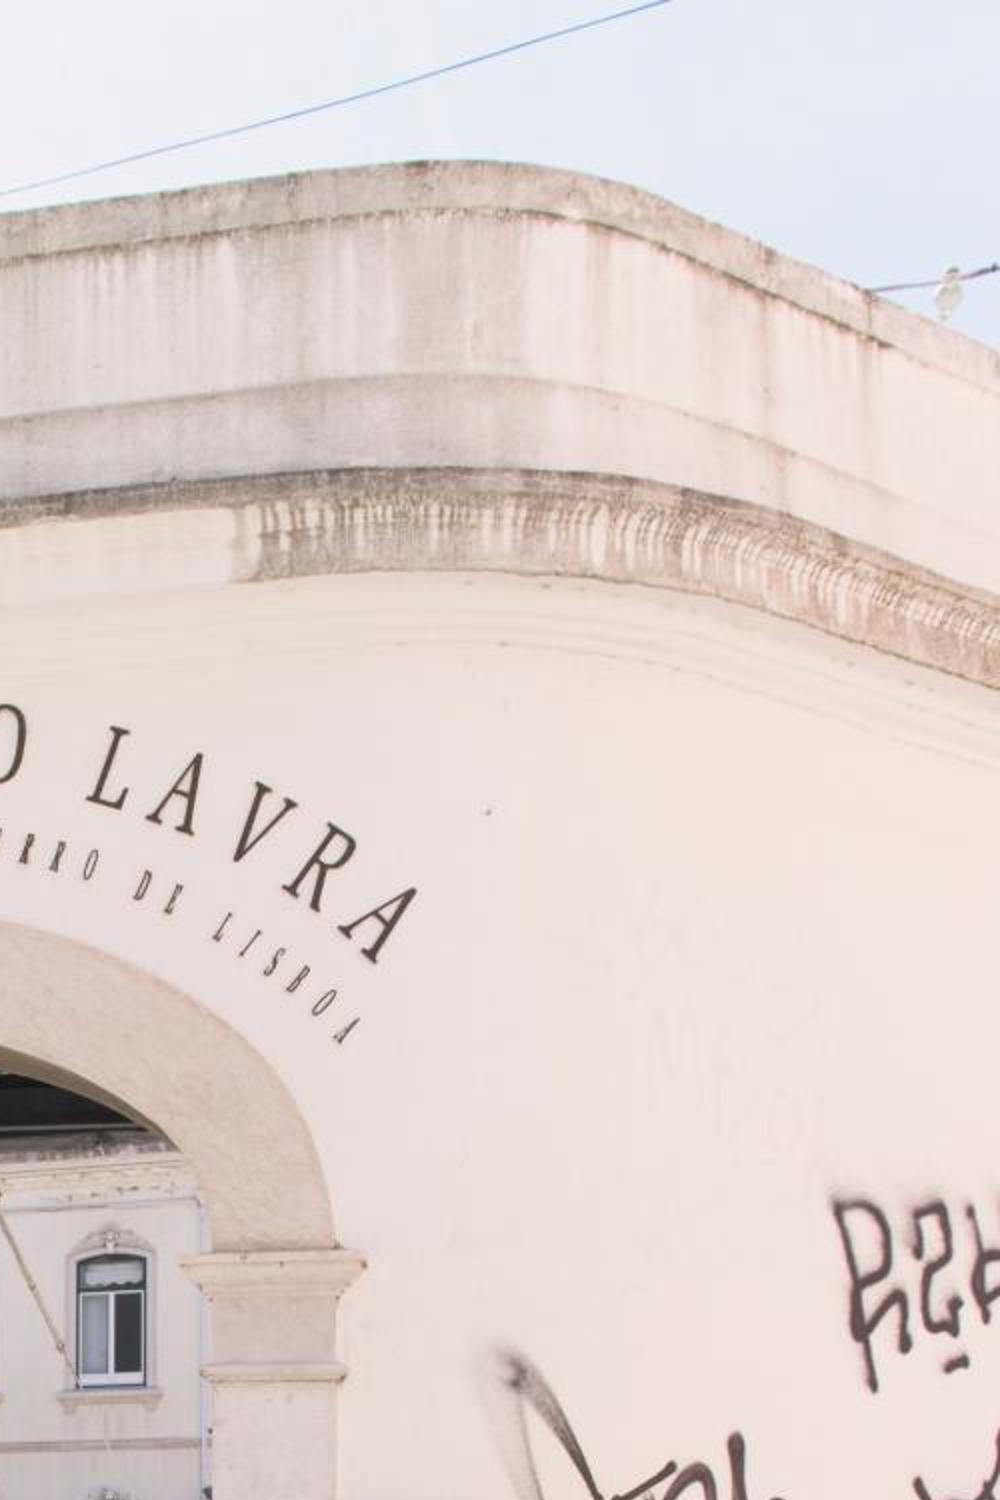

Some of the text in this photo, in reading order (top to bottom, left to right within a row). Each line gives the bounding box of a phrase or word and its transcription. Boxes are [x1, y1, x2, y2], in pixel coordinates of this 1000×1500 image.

[84, 724, 419, 966] LAVRA
[131, 868, 185, 916] DE
[211, 911, 361, 1046] LISBOA
